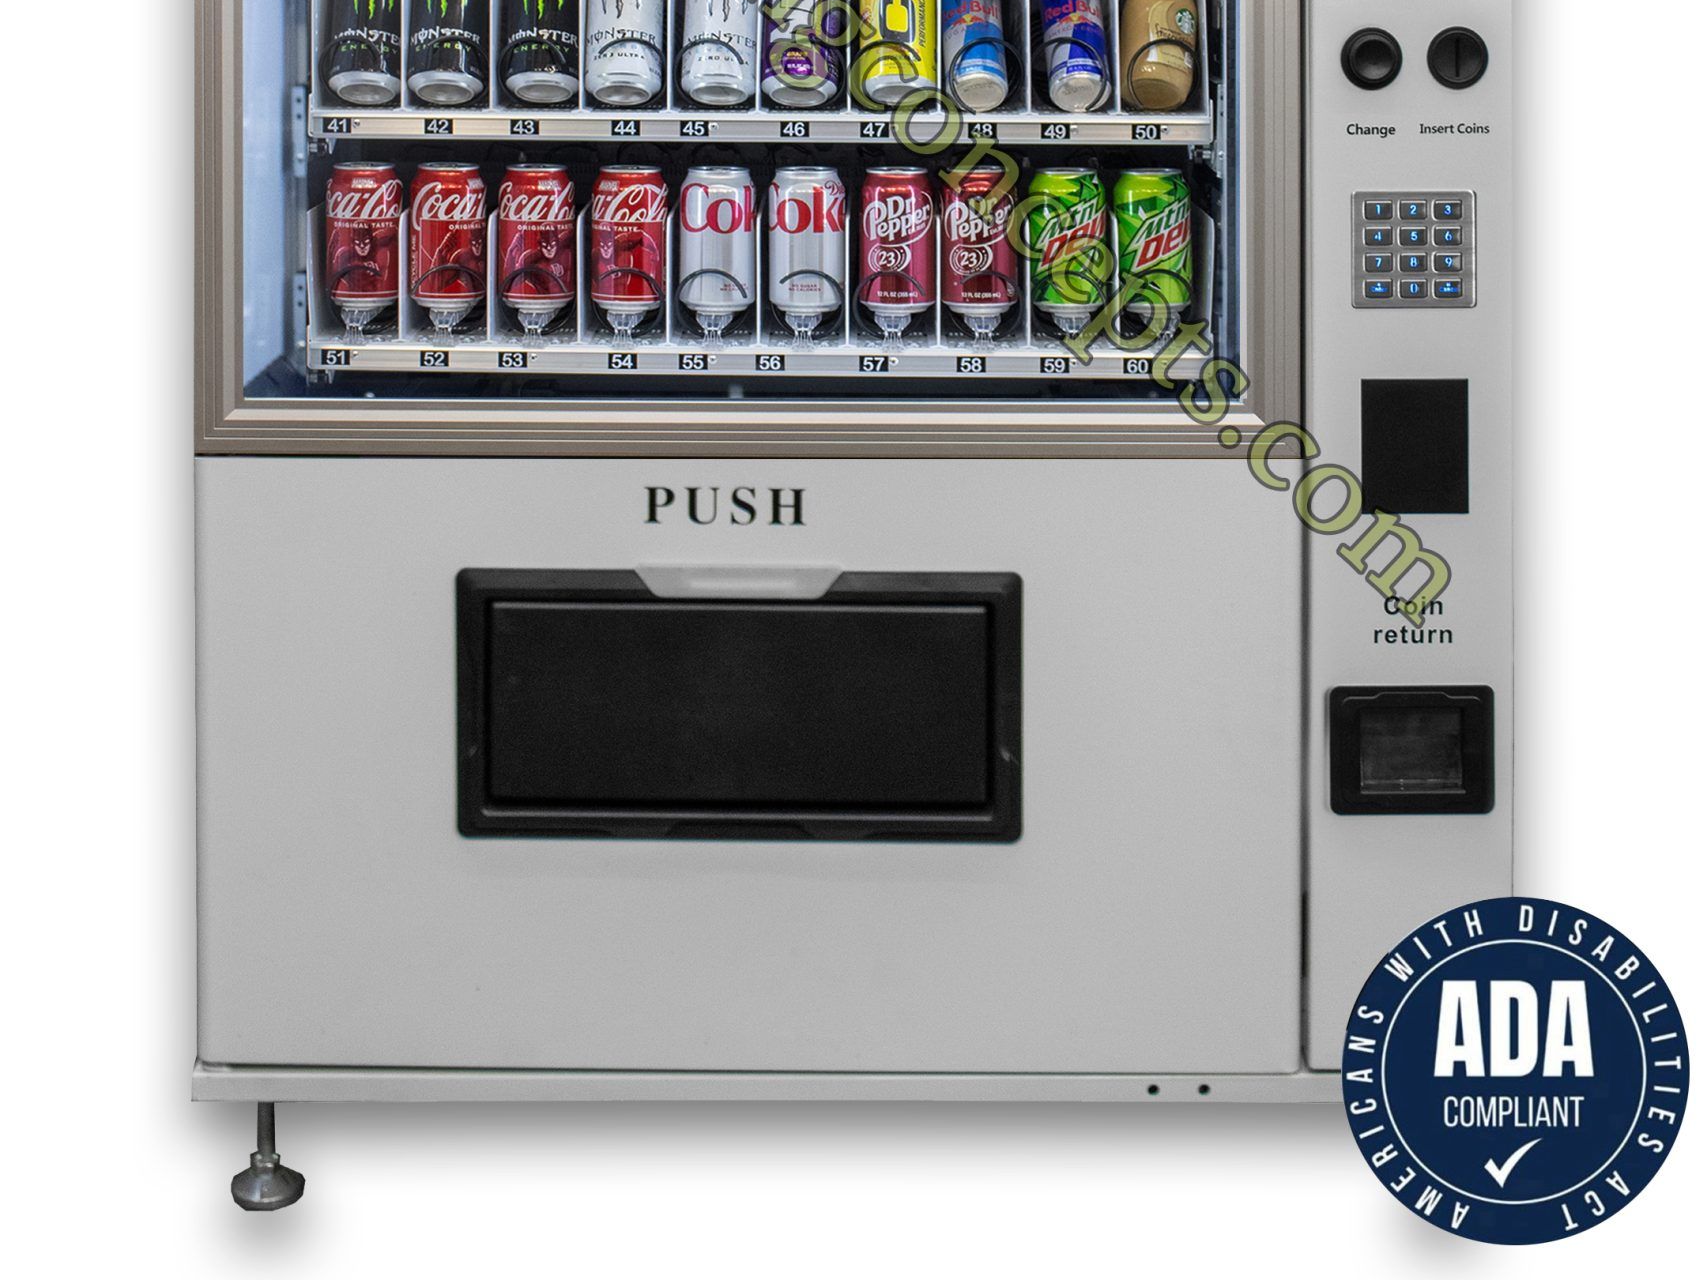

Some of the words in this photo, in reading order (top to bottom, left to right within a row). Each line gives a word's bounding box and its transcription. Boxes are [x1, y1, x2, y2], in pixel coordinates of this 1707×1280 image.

[1044, 0, 1073, 19] Red
[327, 119, 347, 132] 41
[427, 120, 449, 133] 42
[513, 120, 535, 133] 43
[614, 122, 636, 135] 44
[682, 122, 704, 135] 45
[783, 123, 805, 136] 46
[863, 122, 884, 136] 47
[1044, 124, 1066, 138] 49
[1135, 125, 1157, 138] 50
[1346, 123, 1396, 138] Change
[1419, 123, 1454, 134] Insert
[1457, 123, 1490, 134] Coins
[887, 196, 914, 219] Dr
[1375, 205, 1381, 214] 1
[1410, 205, 1417, 214] 2
[1444, 205, 1451, 215] 3
[869, 200, 930, 241] Pepper
[951, 201, 1012, 241] Pepper
[1374, 231, 1382, 240] 4
[1411, 231, 1418, 240] 5
[1445, 231, 1452, 241] 6
[879, 251, 896, 266] 23
[960, 251, 978, 266] 23
[1375, 258, 1382, 267] 7
[1410, 257, 1418, 267] 8
[1445, 257, 1453, 267] 9
[1410, 284, 1418, 293] 0
[326, 351, 344, 365] 51
[424, 352, 445, 366] 52
[502, 353, 524, 367] 53
[611, 355, 633, 368] 54
[682, 355, 704, 369] 55
[759, 356, 781, 370] 56
[863, 357, 884, 371] 57
[960, 358, 981, 371] 58
[1044, 359, 1066, 372] 59
[1127, 359, 1149, 373] 60
[644, 486, 806, 526] PUSH
[1384, 596, 1443, 615] Coin
[1374, 626, 1453, 644] return
